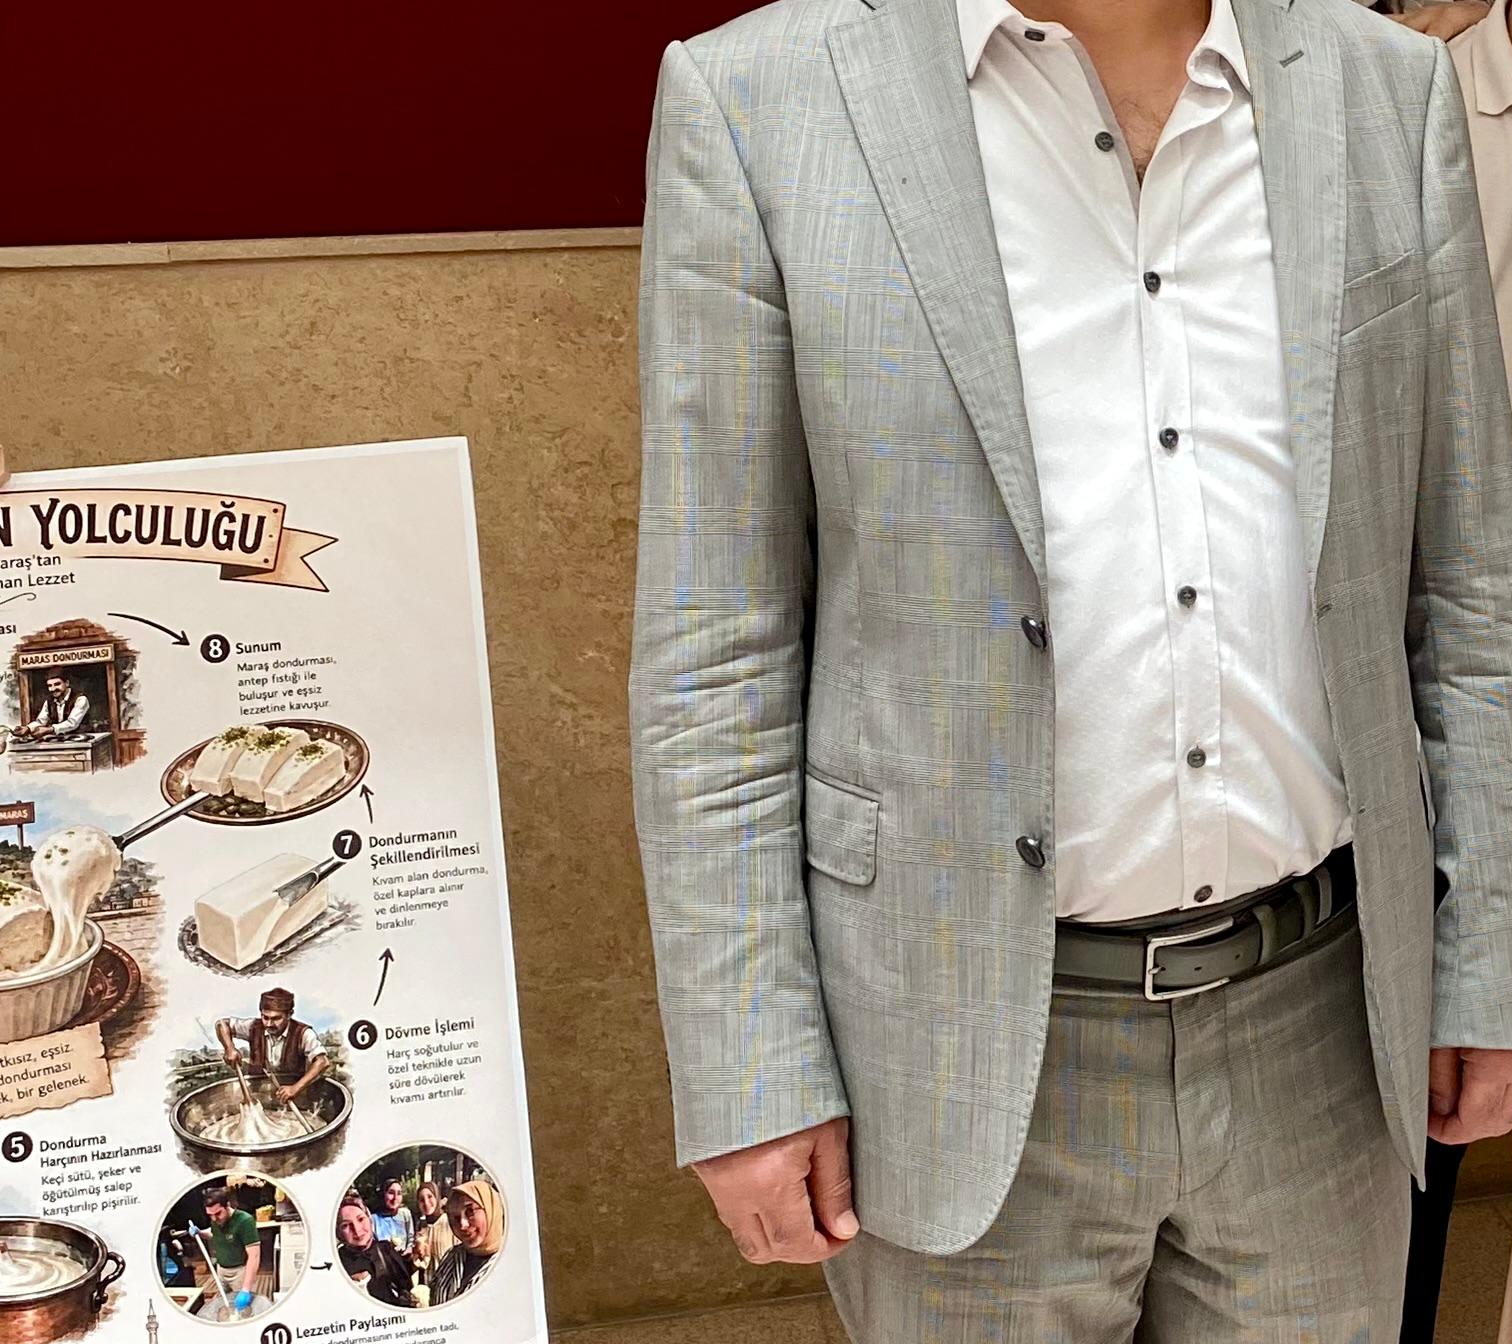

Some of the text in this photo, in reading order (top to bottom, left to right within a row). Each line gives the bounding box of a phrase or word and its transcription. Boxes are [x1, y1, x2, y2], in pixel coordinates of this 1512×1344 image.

[30, 498, 267, 554] YOLCULUĞU
[28, 572, 75, 586] Lezzet
[52, 648, 109, 662] DONDURMASI
[209, 639, 281, 658] 8 Sunum
[237, 663, 269, 672] Maraş
[238, 672, 316, 687] antep fıstığı ile
[239, 690, 278, 701] buluşur
[297, 686, 322, 696] eşsiz
[240, 704, 286, 715] lezzetine
[340, 830, 457, 855] 7 Dondurmanın
[370, 842, 480, 869] Şekillendirilmesi
[372, 867, 488, 886] Kıvam alan dondurma,
[373, 883, 464, 903] özel kaplara alınır
[374, 899, 449, 916] ve dinlenmeye
[356, 1017, 475, 1045] 6 Dövme İşlemi
[387, 1041, 479, 1060] Harç soğutulur ve
[388, 1056, 482, 1074] özel teknikle uzun
[389, 1071, 466, 1090] süre dövülerek
[16, 1088, 35, 1099] bir
[390, 1094, 425, 1104] kıvamı
[10, 1135, 107, 1158] 5 Dondurma
[40, 1143, 162, 1168] Harçının Hazırlanması
[41, 1165, 142, 1186] Keçi sütü, şeker ve
[42, 1181, 133, 1202] öğütülmüş salep
[43, 1201, 98, 1217] karıştırılıp
[295, 1323, 346, 1339] Lezzetin
[349, 1314, 407, 1334] Paylaşımı
[395, 1326, 437, 1338] serinleten
